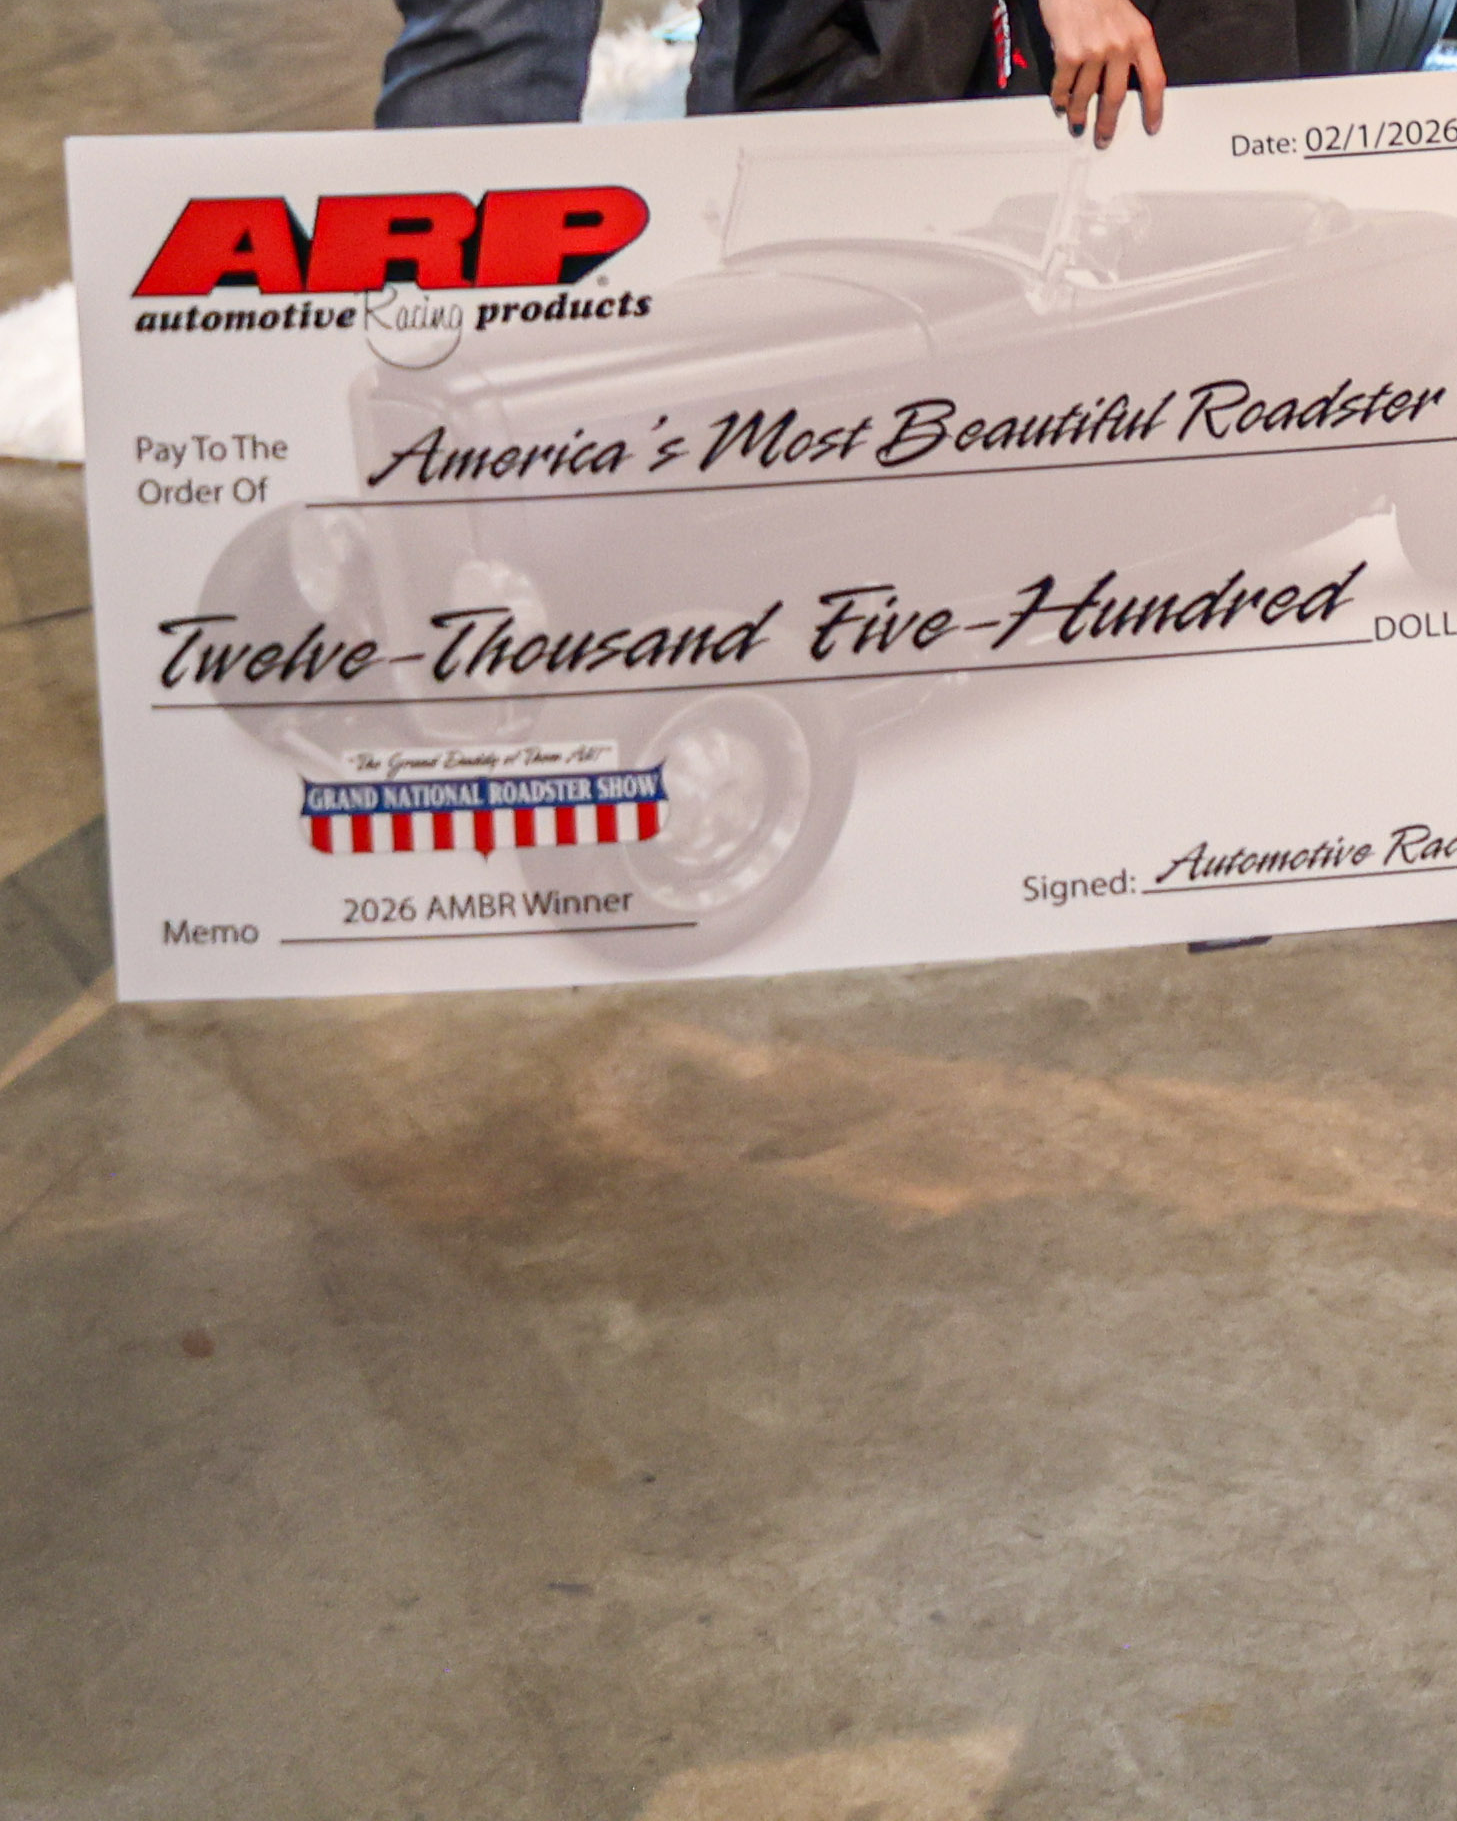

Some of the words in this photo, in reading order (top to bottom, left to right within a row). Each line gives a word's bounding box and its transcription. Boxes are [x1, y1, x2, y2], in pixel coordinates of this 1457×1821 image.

[1231, 130, 1298, 159] Date:
[131, 185, 649, 298] ARP
[134, 301, 356, 334] automotive
[363, 288, 464, 339] Racing
[476, 289, 653, 331] products
[136, 436, 185, 466] Pay
[193, 435, 226, 462] To
[232, 433, 289, 461] The
[368, 414, 690, 487] America's
[697, 410, 875, 471] Most
[876, 391, 1176, 468] Beautiful
[1178, 377, 1447, 444] Roadster
[138, 479, 224, 505] Order
[232, 477, 270, 504] Of
[307, 784, 379, 811] GRAND
[384, 779, 483, 809] NATIONAL
[488, 776, 593, 805] ROADSTER
[597, 772, 661, 799] SHOW
[1022, 871, 1137, 907] Signed:
[1155, 837, 1374, 886] Automotive
[162, 919, 260, 945] Memo
[342, 897, 418, 925] 2026
[426, 893, 516, 921] AMBR
[521, 888, 634, 918] Winner
